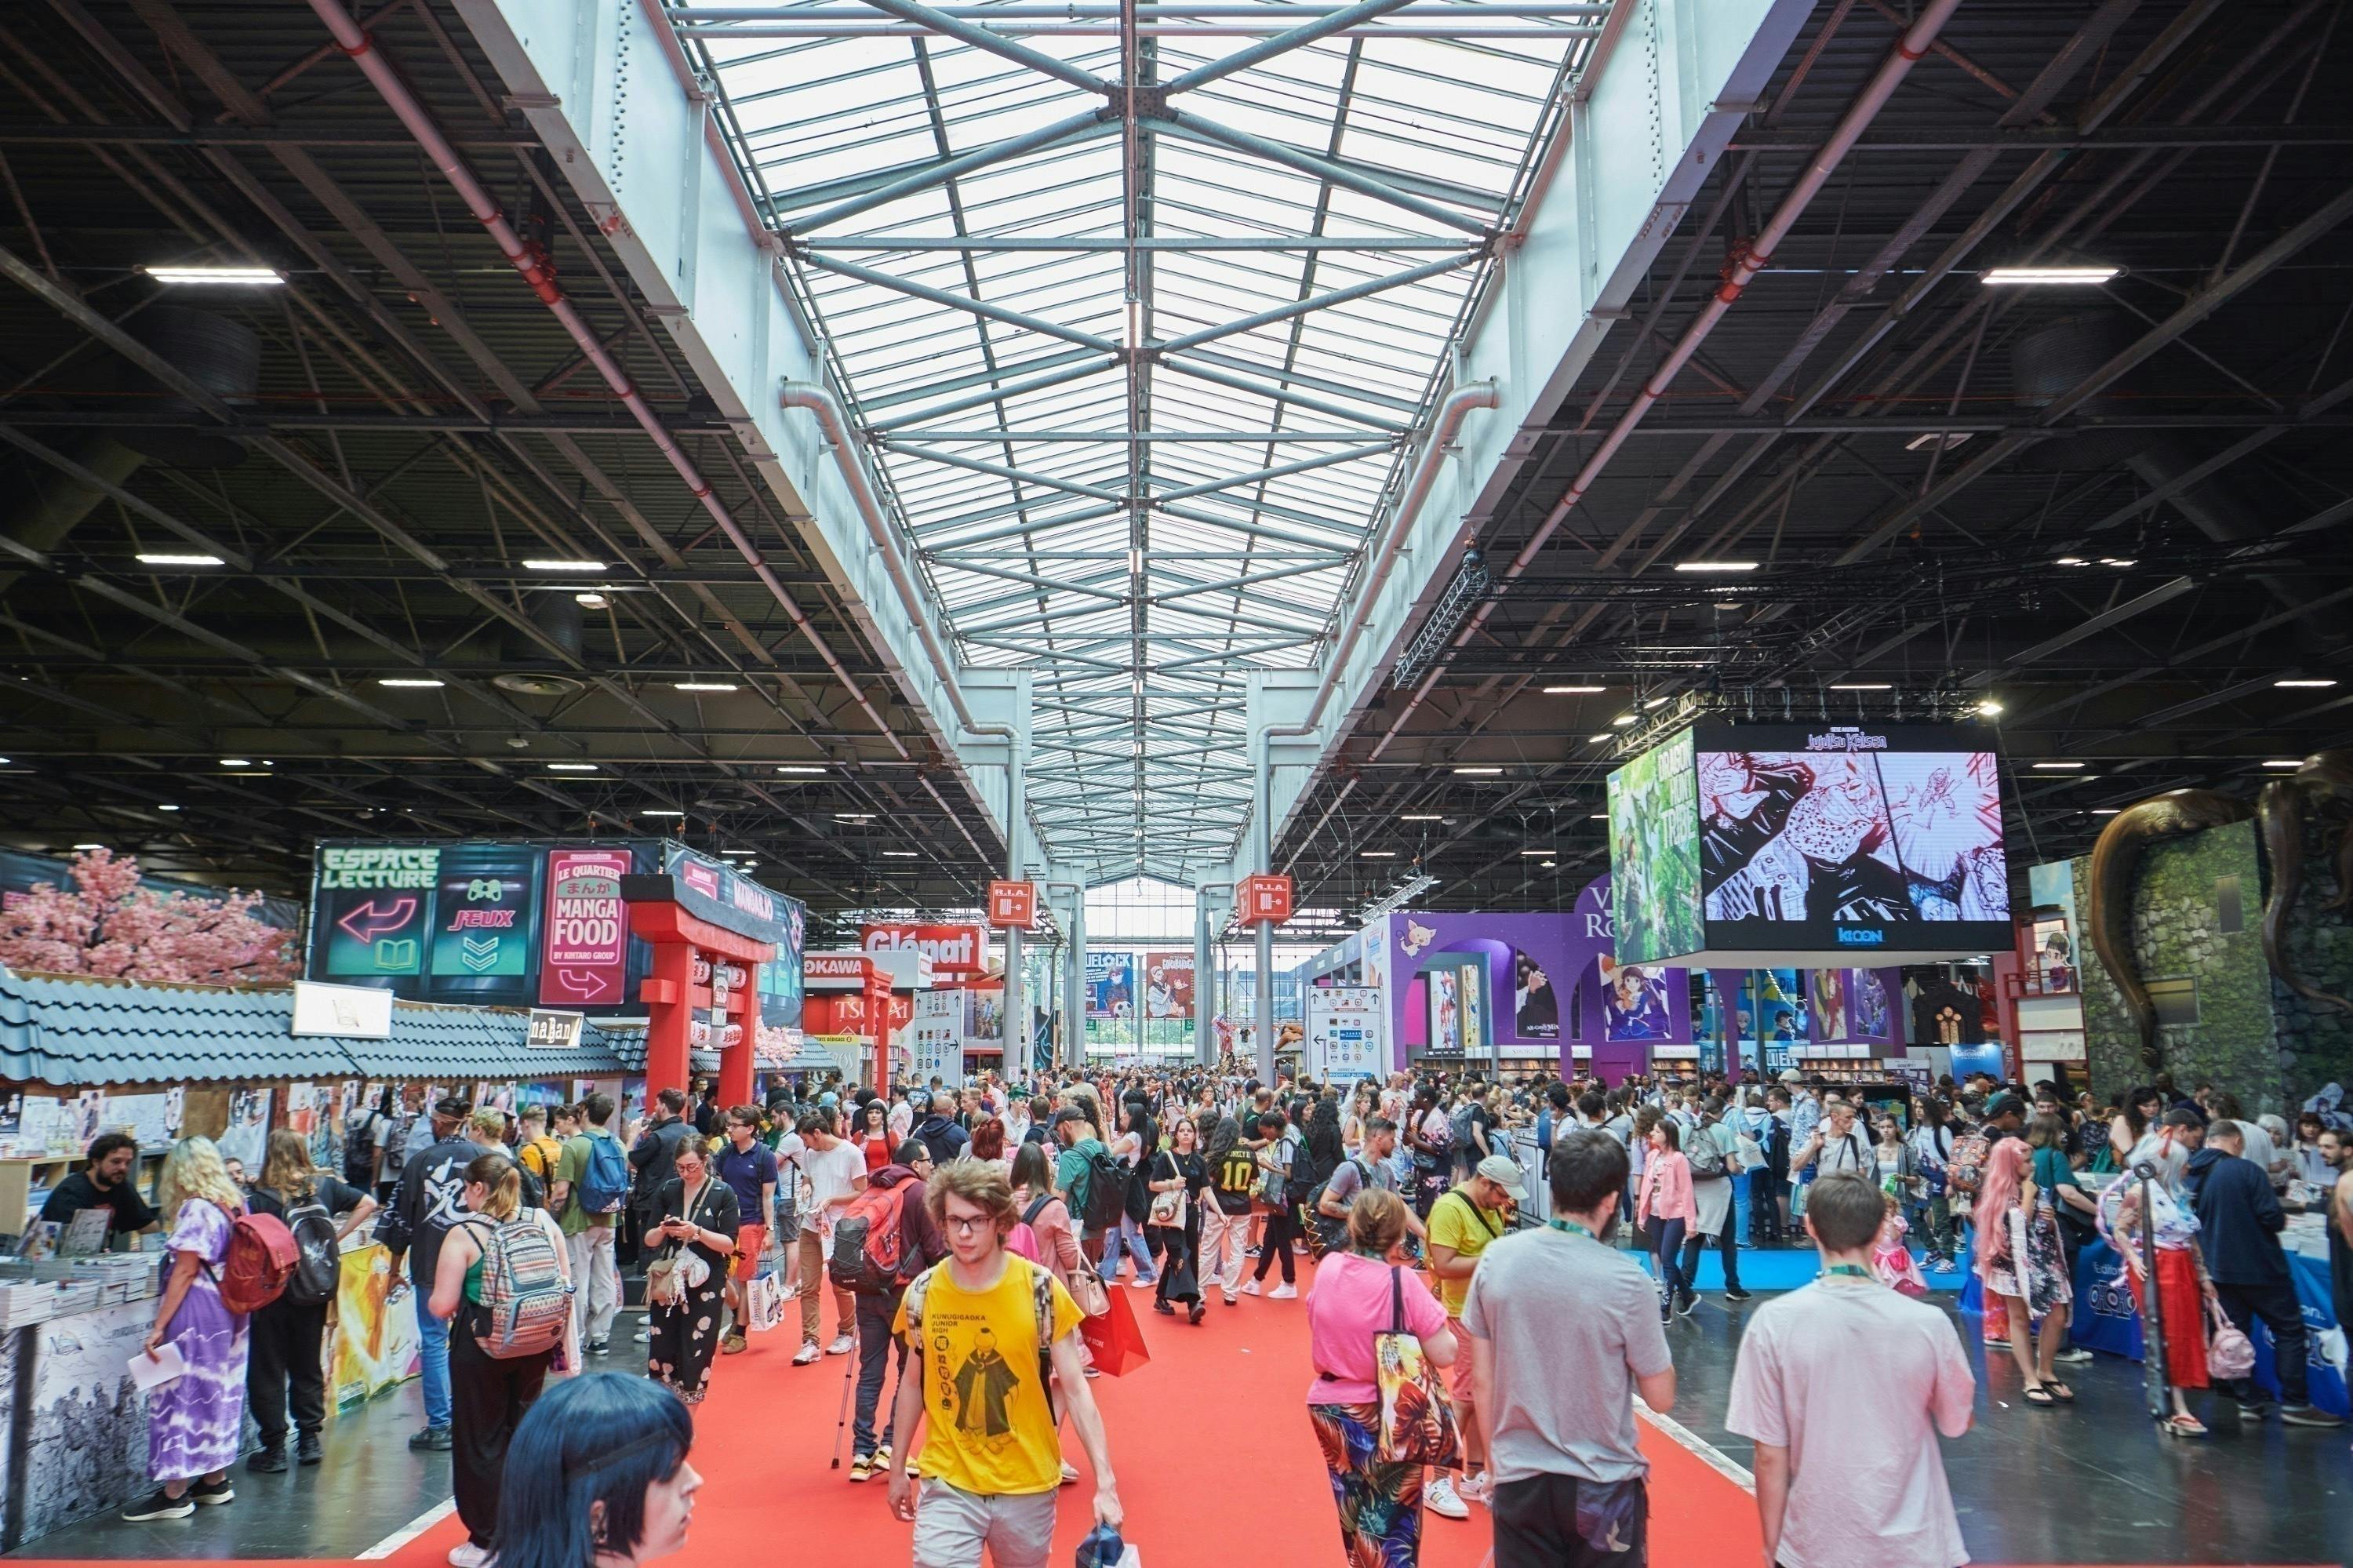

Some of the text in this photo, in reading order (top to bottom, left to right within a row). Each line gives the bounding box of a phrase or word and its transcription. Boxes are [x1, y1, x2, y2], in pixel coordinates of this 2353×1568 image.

[322, 848, 440, 870] ESPACE
[321, 869, 438, 888] LECTURE
[558, 864, 620, 881] LE QUARTIER
[556, 898, 618, 919] MANGA
[447, 910, 515, 931] JEUX
[553, 919, 618, 945] FOOD
[865, 930, 973, 964] Glénat
[804, 960, 862, 973] OKAWA
[1086, 953, 1131, 967] UELOCK
[1162, 959, 1195, 970] GOKURAKUGA
[1221, 1161, 1253, 1191] 10
